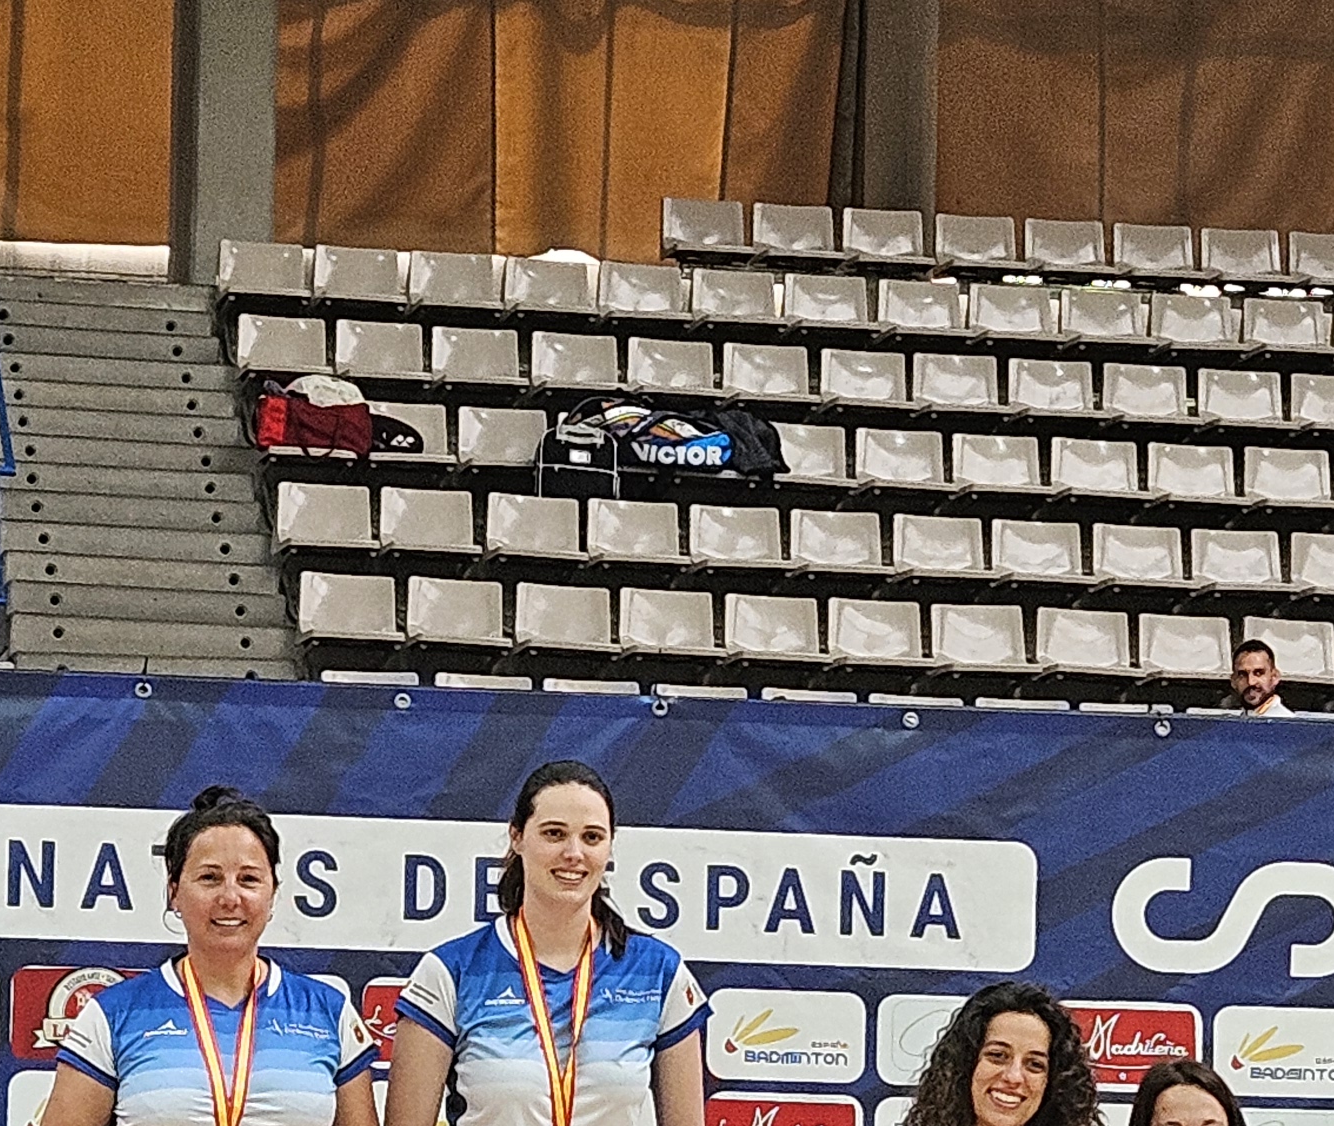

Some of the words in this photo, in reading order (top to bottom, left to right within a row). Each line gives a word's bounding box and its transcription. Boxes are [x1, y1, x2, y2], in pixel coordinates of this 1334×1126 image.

[631, 439, 728, 467] VICTOR
[609, 852, 963, 941] SPAÑA
[744, 1049, 849, 1067] BADMINTON
